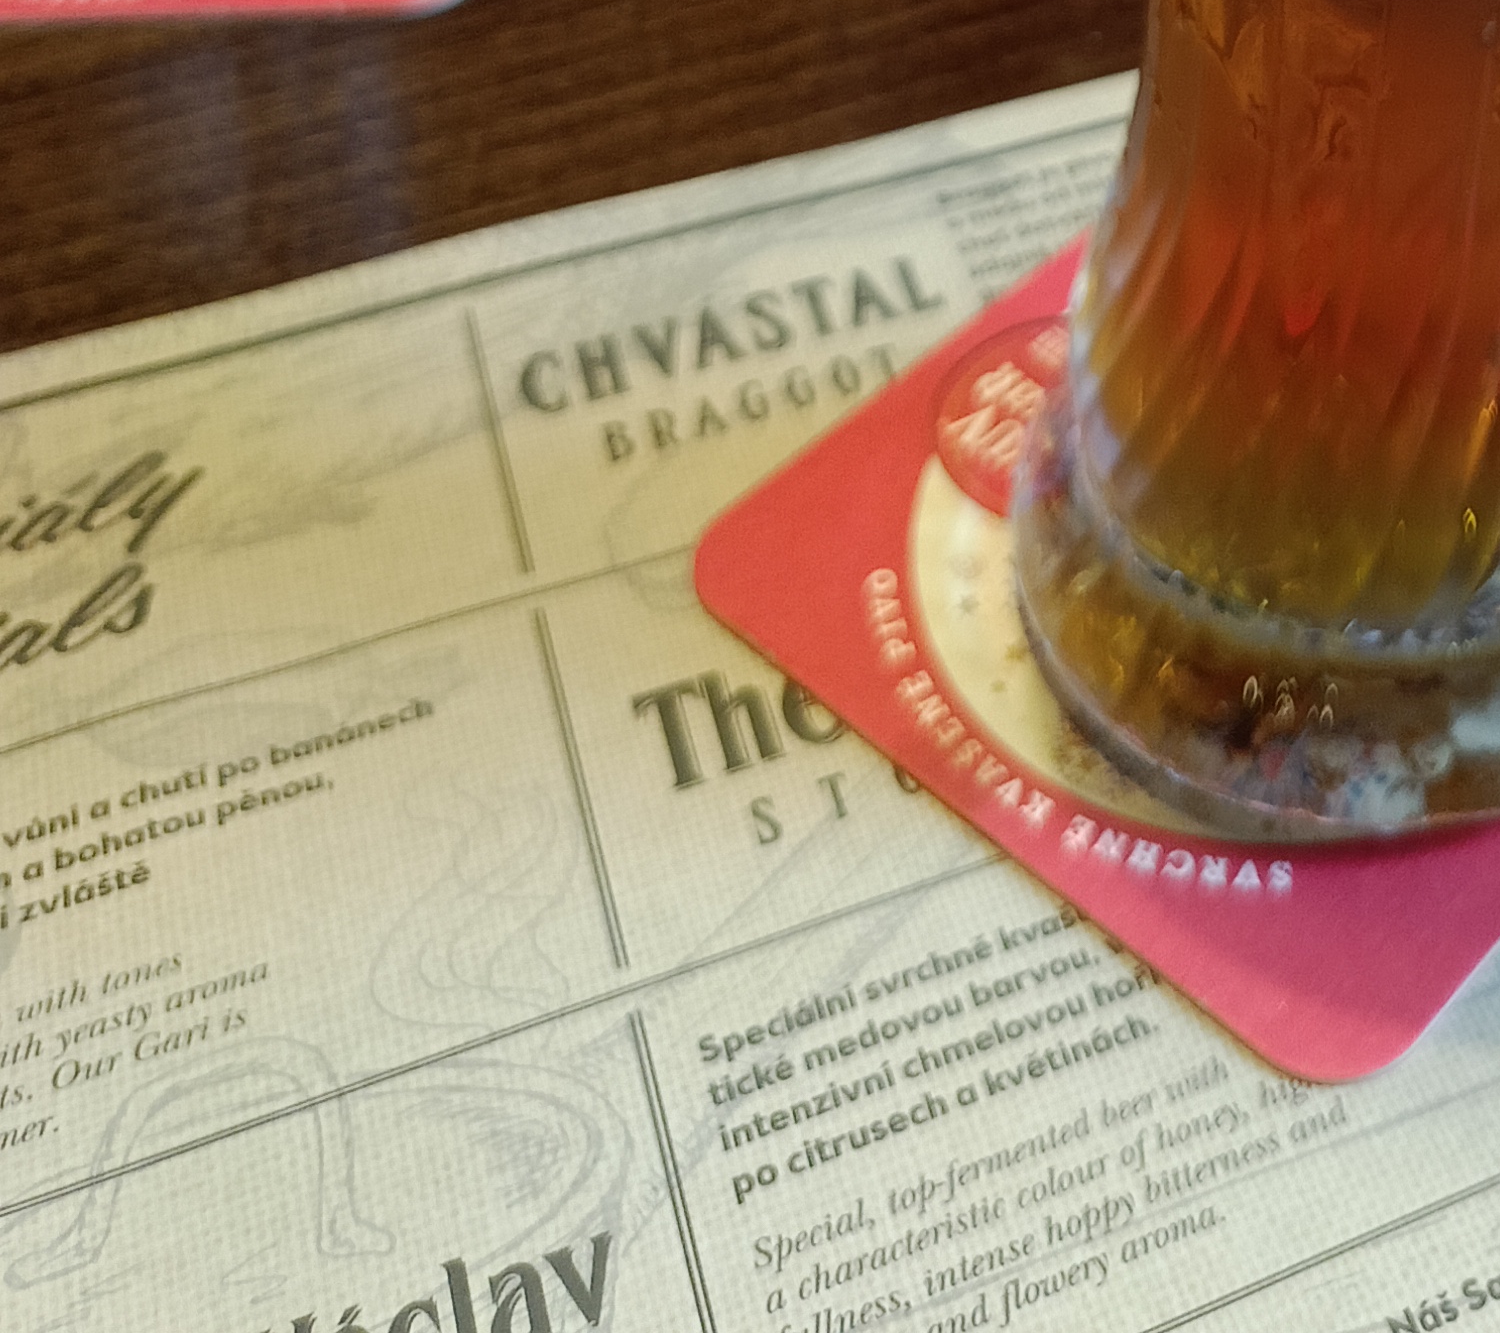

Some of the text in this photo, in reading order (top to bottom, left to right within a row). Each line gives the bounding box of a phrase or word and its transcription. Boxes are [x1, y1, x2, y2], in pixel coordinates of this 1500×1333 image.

[519, 254, 948, 414] CHVASTAL
[601, 341, 901, 463] BRAGGOT
[90, 798, 111, 821] a
[217, 755, 260, 788] po
[269, 697, 436, 766] banánech
[22, 858, 45, 882] a
[54, 806, 207, 871] bohatou
[0, 962, 269, 1070] ith yeasty aroma
[15, 953, 183, 1024] with tones
[51, 1051, 124, 1090] Our
[134, 1015, 210, 1062] Gari
[222, 1006, 248, 1033] is
[698, 982, 856, 1066] Speciální
[708, 1055, 795, 1106] tické
[804, 993, 965, 1073] medovou
[719, 1059, 895, 1153] intenzivní
[904, 993, 1088, 1081] chmelovou
[731, 1163, 778, 1205] po
[787, 1091, 949, 1175] citrusech
[956, 1082, 980, 1106] a
[752, 1053, 1231, 1272] Special, top-fermented beer with
[766, 1288, 786, 1315] a
[798, 1196, 1005, 1301] characteristic
[1017, 1150, 1111, 1211] colour
[1121, 1132, 1149, 1174] of
[1155, 1099, 1250, 1157] honey,
[780, 1093, 1348, 1333] llness, intense hoppy bitterness and
[1000, 1249, 1111, 1328] flowery
[1120, 1202, 1227, 1265] aroma.
[1385, 1289, 1460, 1333] Náš
